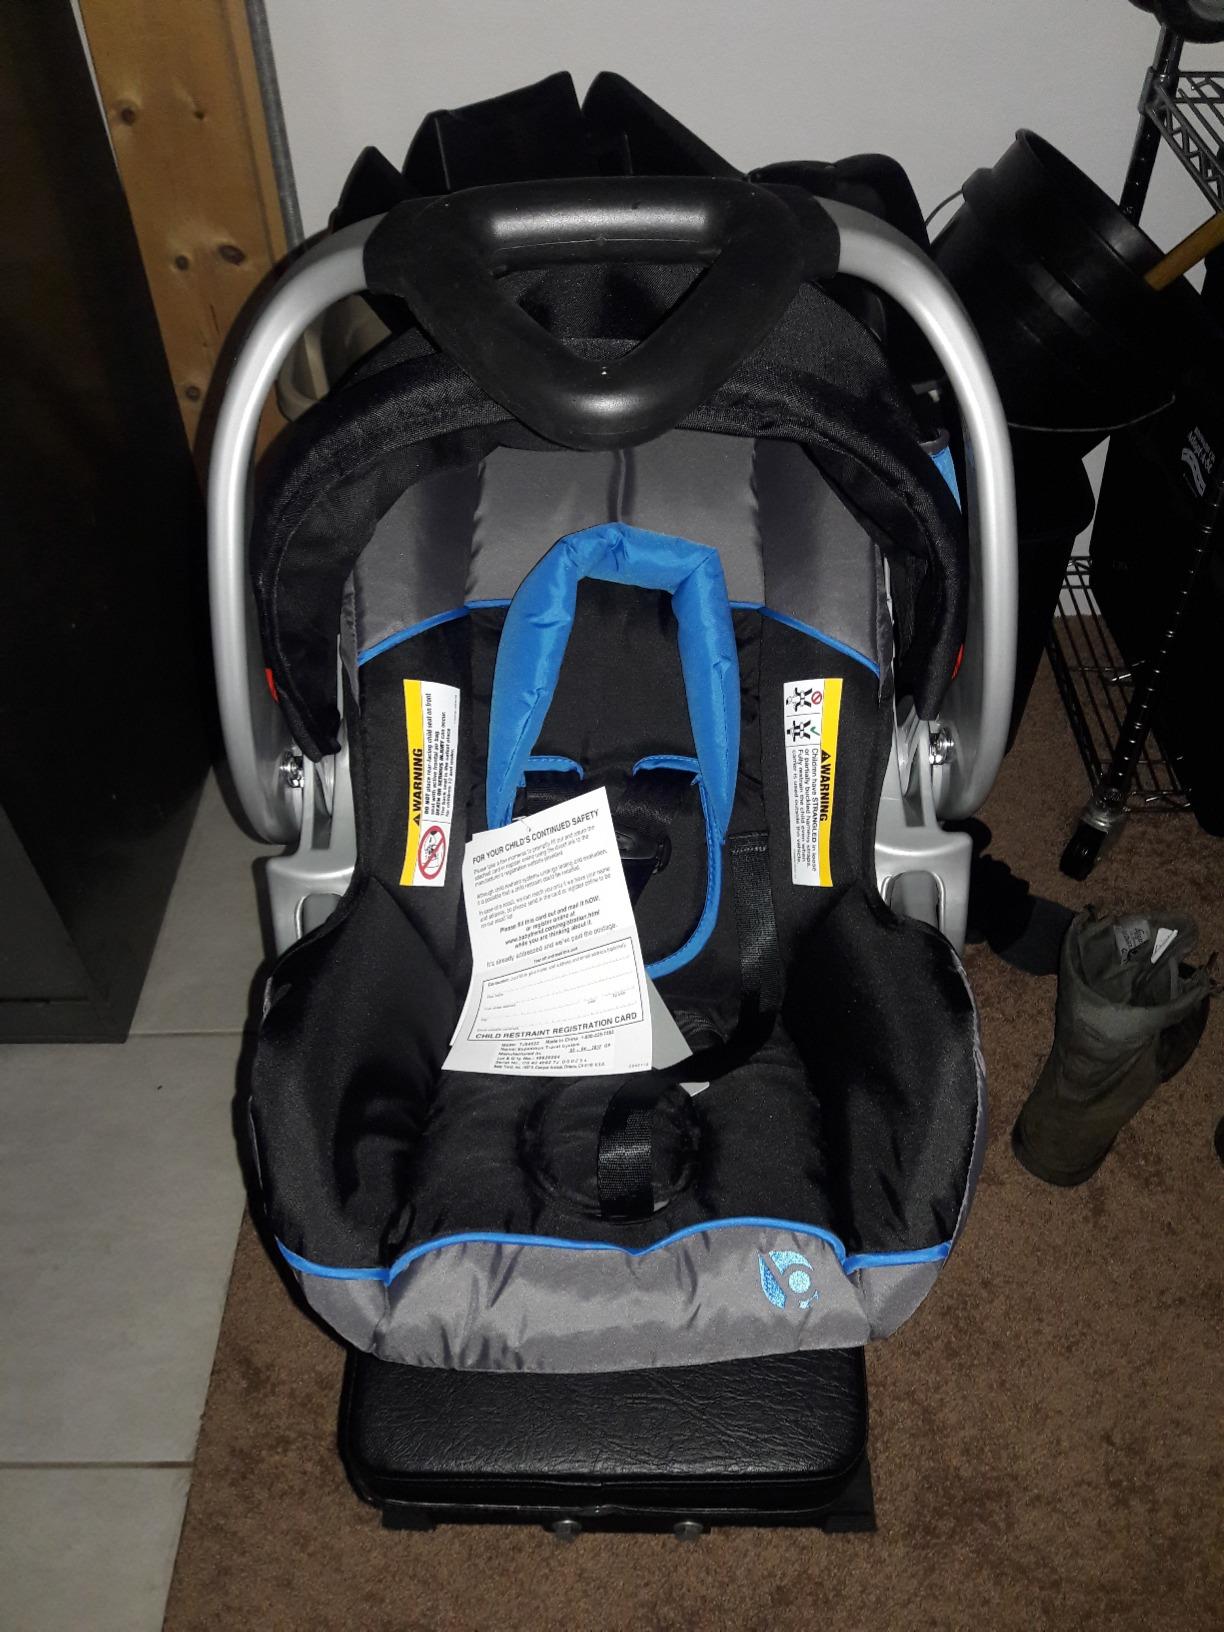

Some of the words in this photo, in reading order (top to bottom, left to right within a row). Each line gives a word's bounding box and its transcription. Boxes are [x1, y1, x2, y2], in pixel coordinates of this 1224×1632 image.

[413, 749, 422, 811] WARNING
[820, 764, 831, 821] WARNING
[473, 853, 484, 864] FOR
[487, 846, 502, 859] YOUR
[506, 835, 530, 851] CHILD'S
[532, 819, 569, 841] CONTINUED
[572, 808, 598, 825] SAFETY
[500, 923, 516, 934] Please
[535, 912, 546, 922] card
[557, 905, 566, 914] and
[568, 901, 577, 911] mail
[529, 936, 538, 944] you
[548, 926, 569, 938] thinking
[570, 920, 585, 931] about
[533, 918, 551, 929] register
[553, 912, 568, 922] online
[503, 1029, 549, 1038] RESTRAINT
[552, 1017, 612, 1034] REGISTRATION
[614, 1011, 636, 1023] CARD
